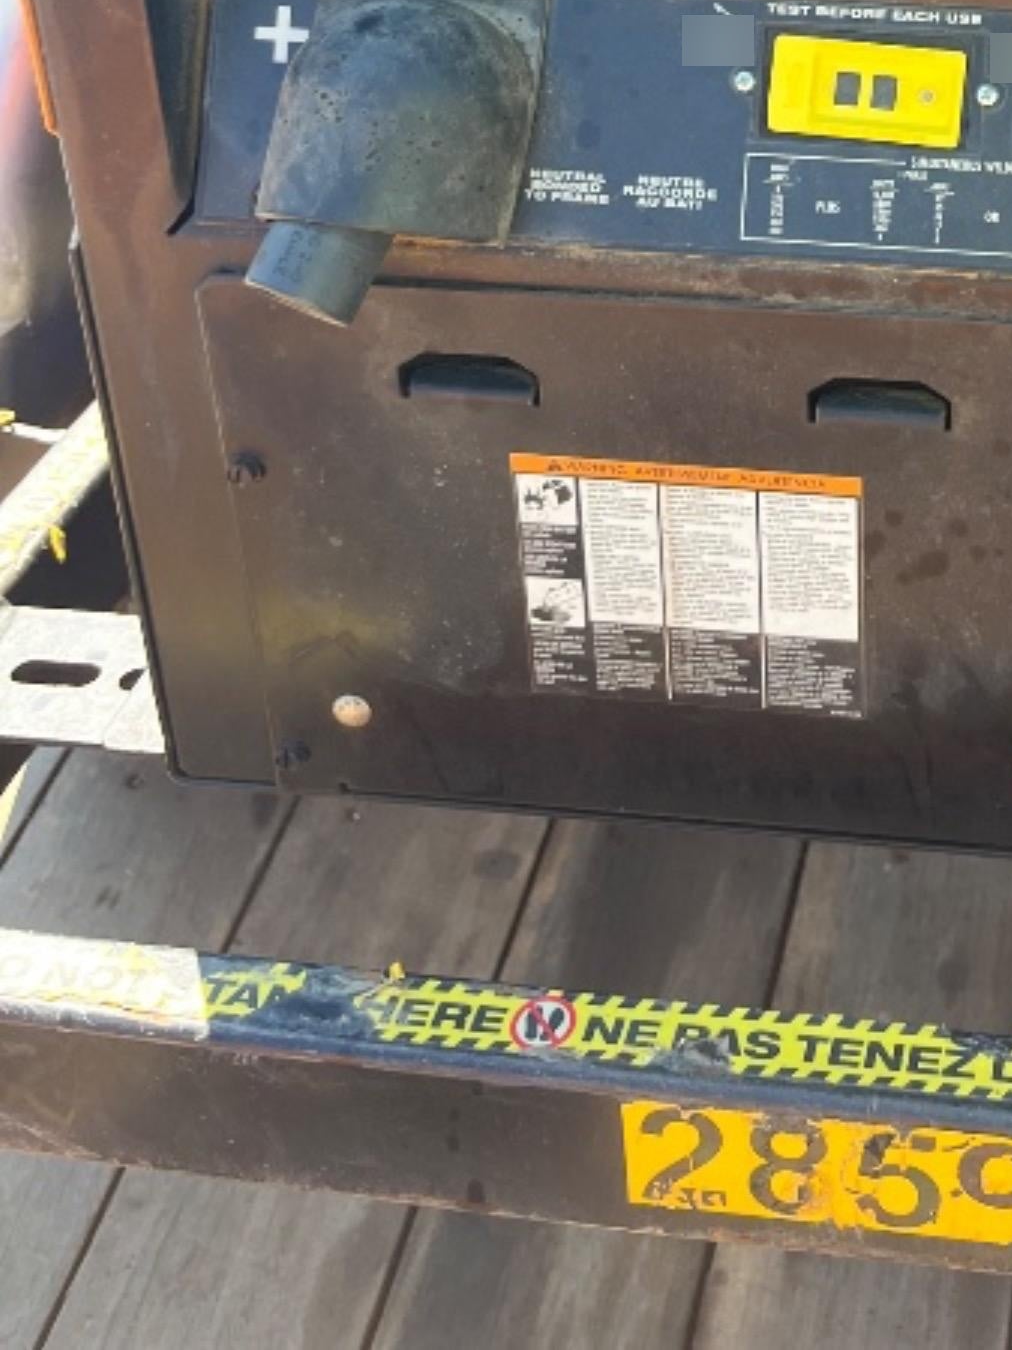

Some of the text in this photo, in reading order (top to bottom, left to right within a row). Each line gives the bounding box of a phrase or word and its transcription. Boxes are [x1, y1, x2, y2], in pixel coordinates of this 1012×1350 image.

[766, 2, 982, 26] TEST BEFORE EACH USE
[529, 167, 607, 184] NEUTRAL
[637, 173, 705, 188] NEUTRE
[983, 209, 1001, 224] OR
[581, 1015, 662, 1049] NE
[673, 1022, 781, 1061] PAS
[795, 1033, 976, 1080] TENEZ
